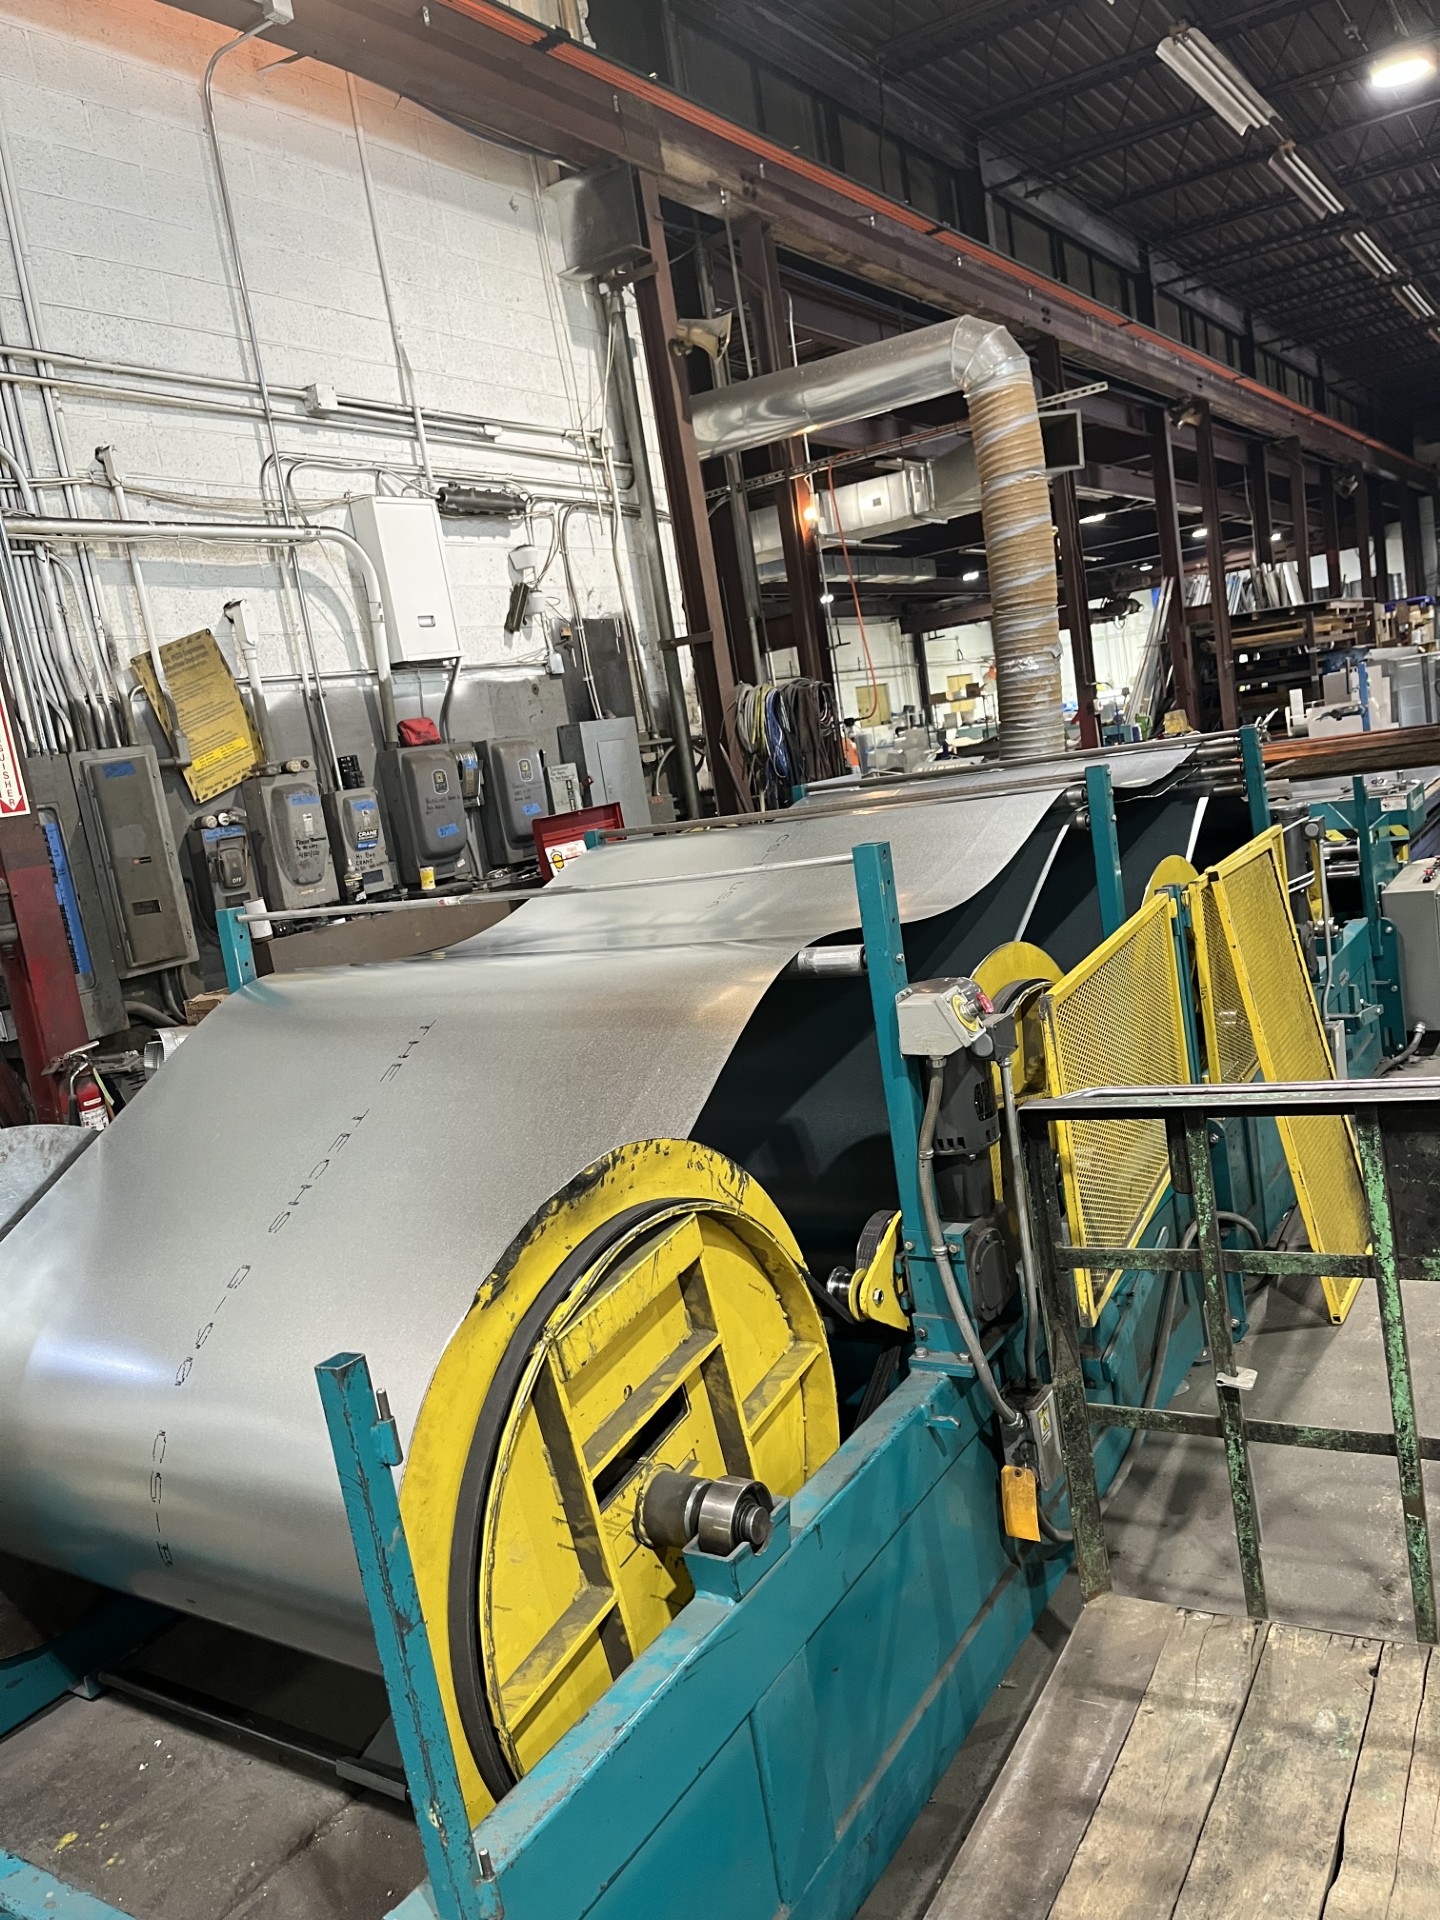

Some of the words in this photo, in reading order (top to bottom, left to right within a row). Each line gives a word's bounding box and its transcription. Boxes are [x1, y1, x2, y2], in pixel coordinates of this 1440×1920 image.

[358, 829, 377, 838] CRANE
[380, 1019, 437, 1083] THE
[268, 1107, 371, 1234] TECHS
